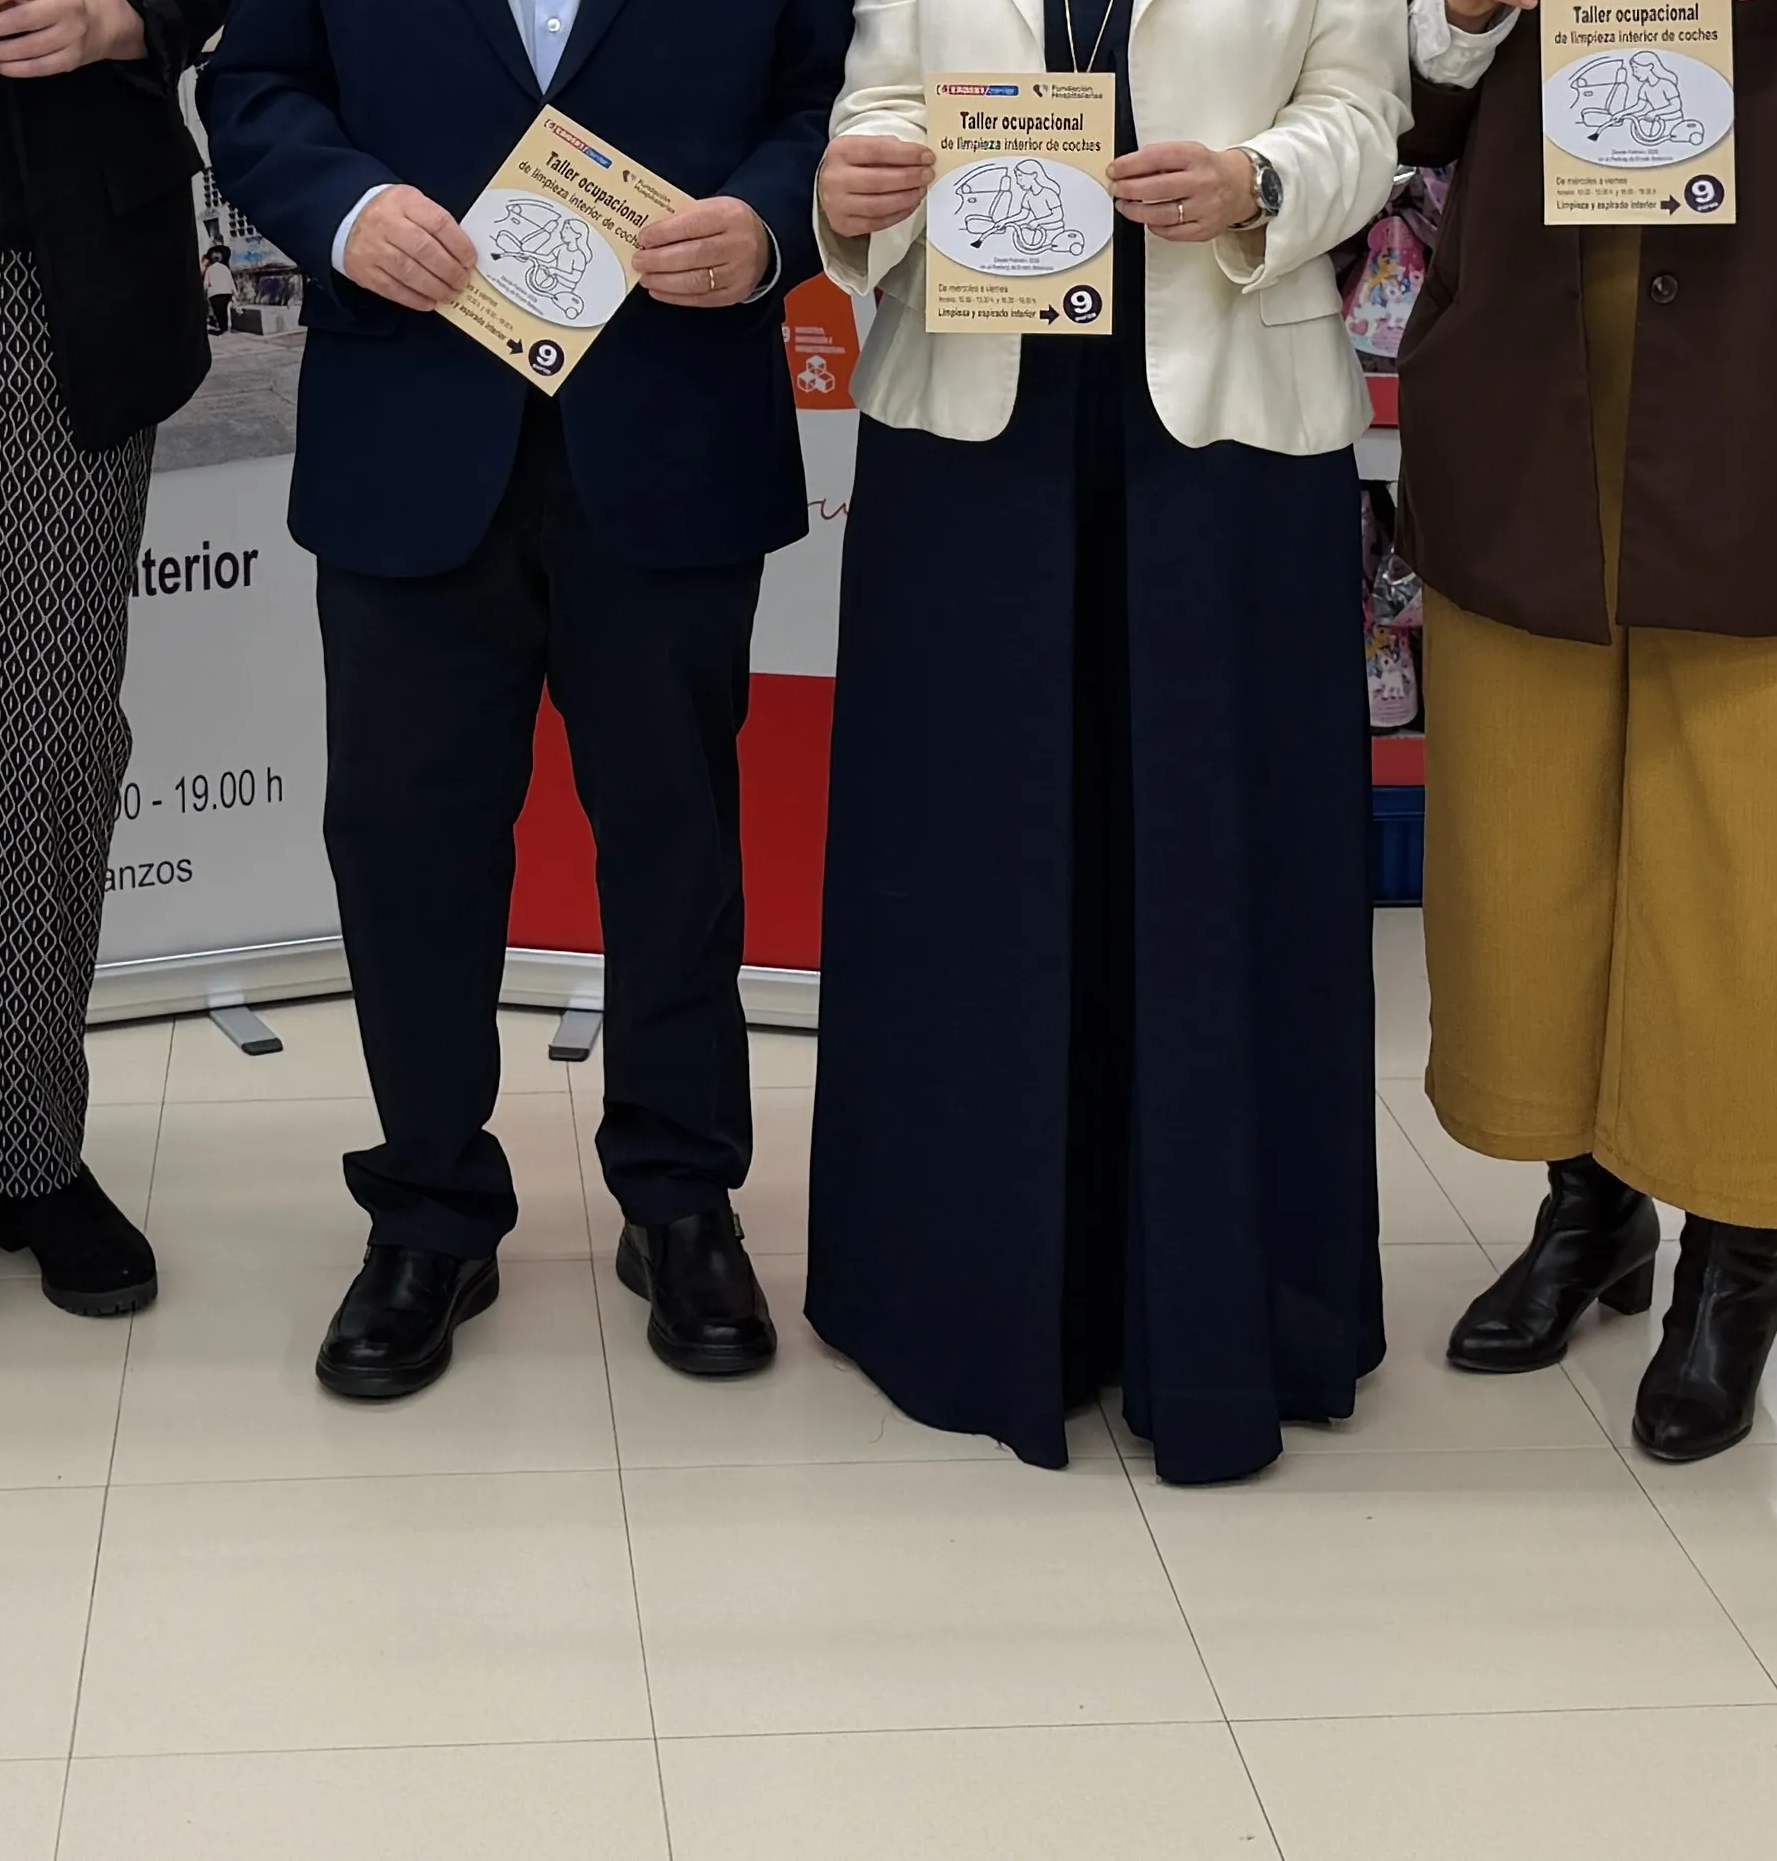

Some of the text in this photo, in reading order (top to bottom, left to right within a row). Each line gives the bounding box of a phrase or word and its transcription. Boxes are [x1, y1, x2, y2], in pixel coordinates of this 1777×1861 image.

[1573, 2, 1698, 26] Taller ocupacional
[1554, 28, 1717, 46] de limpieza interior de coches
[960, 111, 1082, 134] Taller ocupacional
[940, 137, 1100, 152] de limpieza interior de coches
[518, 160, 532, 175] de
[532, 164, 569, 199] limpieza
[569, 191, 601, 221] interior
[602, 216, 616, 233] de
[545, 150, 649, 228] Taller ocupacional
[1691, 179, 1715, 203] 9
[1070, 290, 1093, 313] 9
[536, 344, 558, 367] 9
[175, 769, 256, 814] 19.00
[267, 766, 283, 803] h
